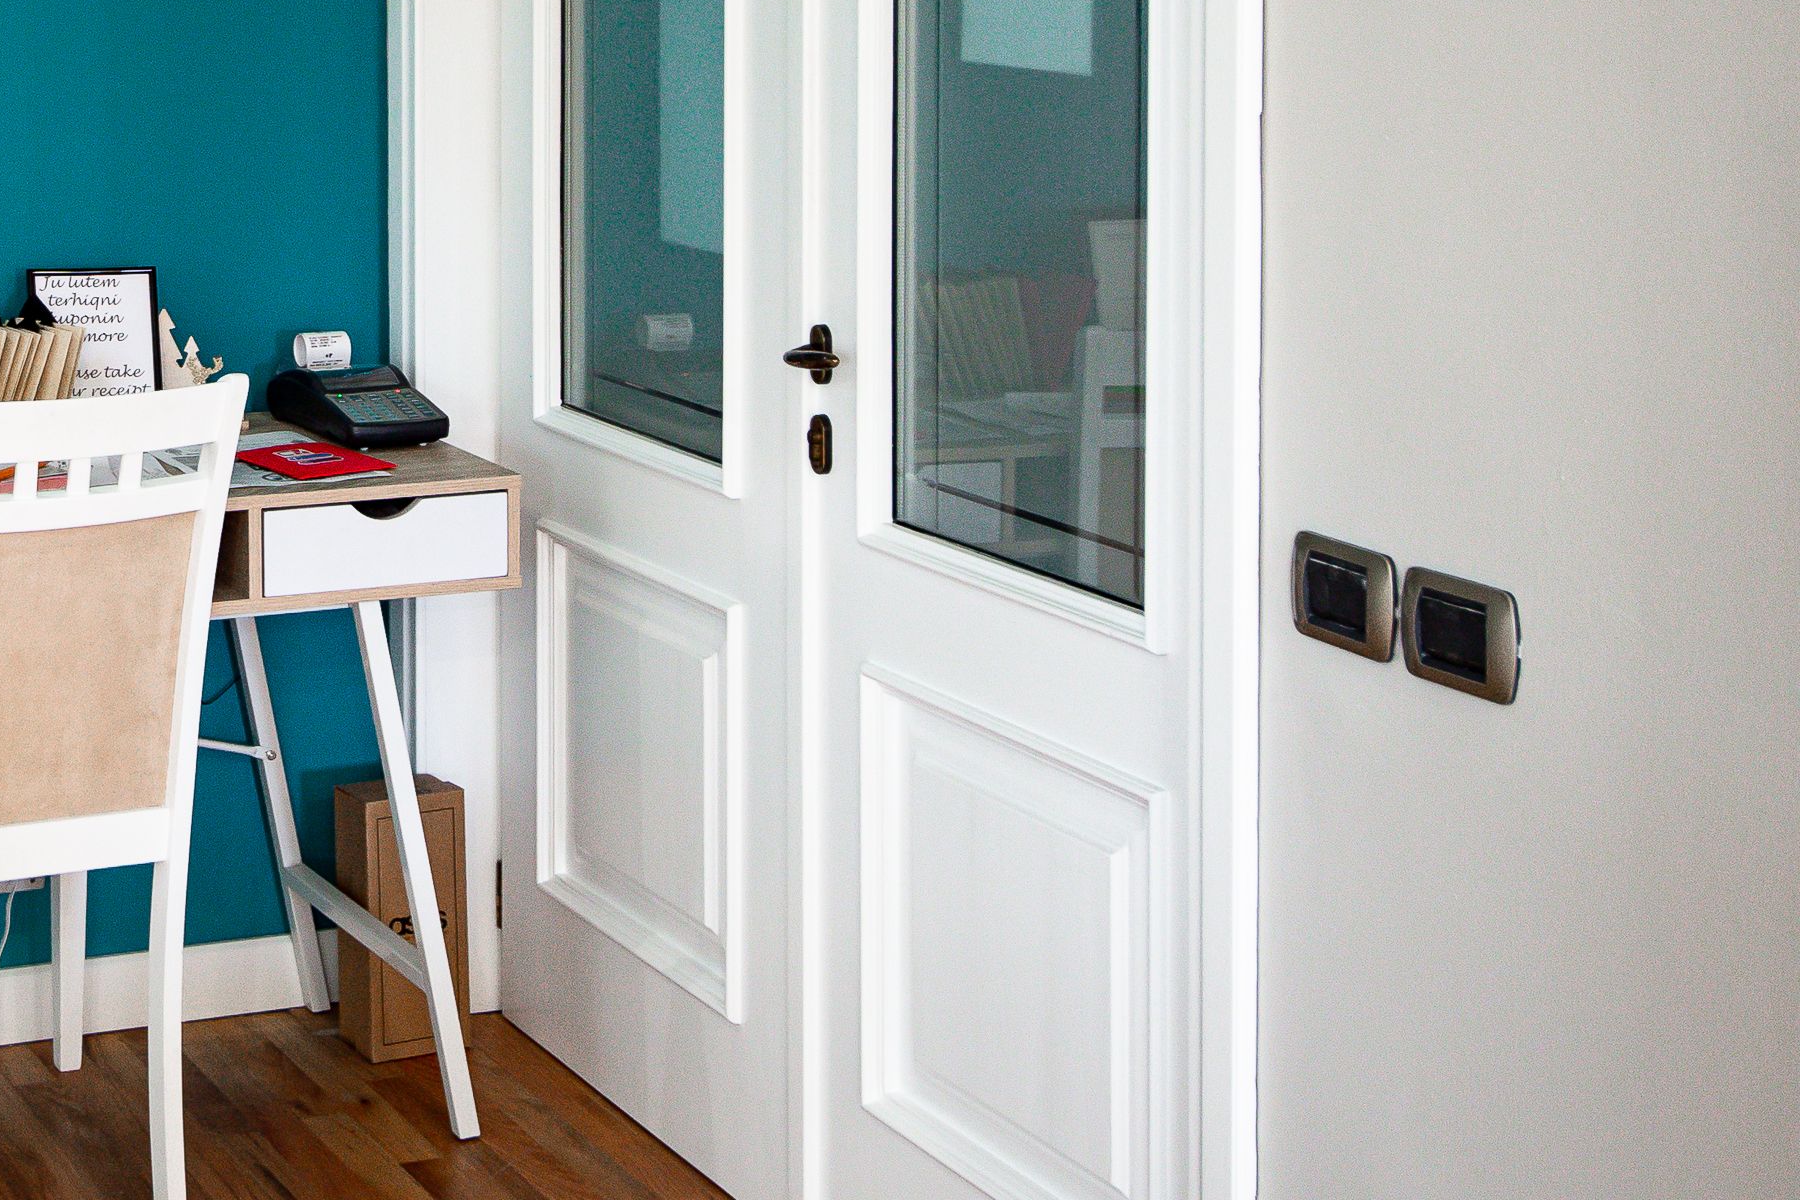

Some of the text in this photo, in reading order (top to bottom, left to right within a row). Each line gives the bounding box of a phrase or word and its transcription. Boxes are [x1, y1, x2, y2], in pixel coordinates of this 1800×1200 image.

[39, 275, 121, 292] Ju lutem
[47, 292, 122, 311] terhiqni
[103, 364, 146, 378] take
